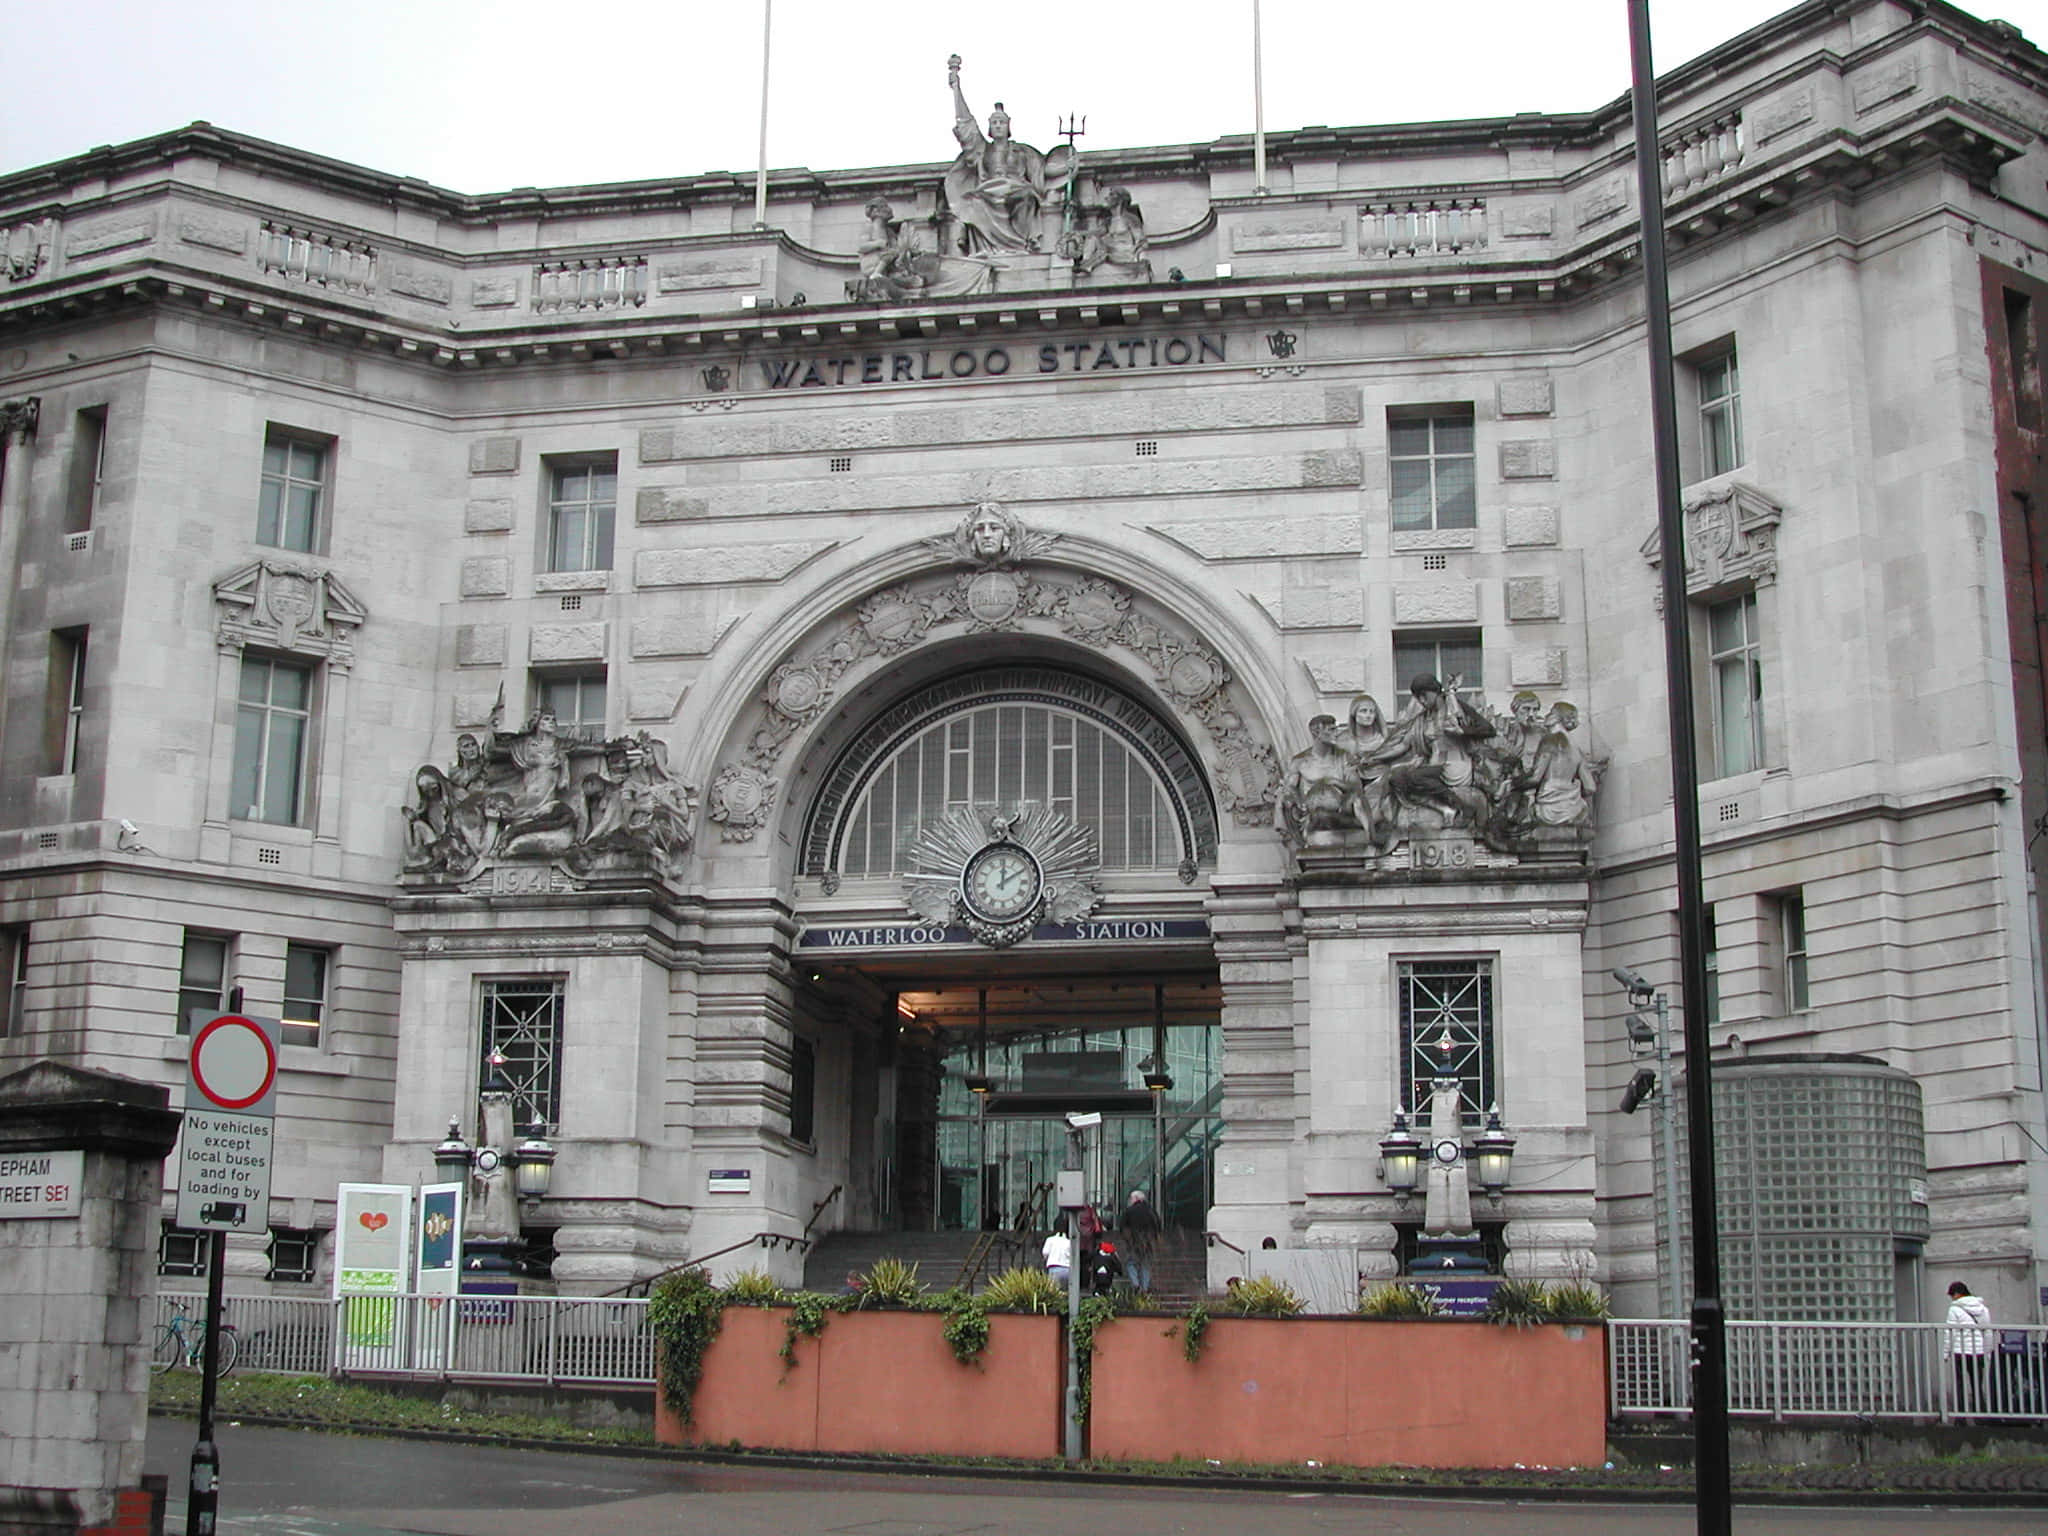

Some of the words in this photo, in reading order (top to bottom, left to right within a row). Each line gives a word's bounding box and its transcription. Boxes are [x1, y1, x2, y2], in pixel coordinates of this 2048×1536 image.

[761, 349, 1012, 389] WATERLOO
[1038, 334, 1228, 373] STATION
[1413, 845, 1466, 868] 1918
[496, 872, 544, 893] 1914
[827, 926, 946, 946] WATERLOO
[1075, 921, 1166, 940] STATION
[188, 1116, 208, 1131] No
[213, 1119, 269, 1137] vehicles
[204, 1136, 251, 1151] except
[187, 1150, 219, 1164] local
[225, 1153, 266, 1168] buses
[200, 1167, 226, 1180] and
[231, 1170, 251, 1182] for
[45, 1184, 70, 1202] SE1
[187, 1179, 239, 1197] loading
[244, 1183, 261, 1200] by
